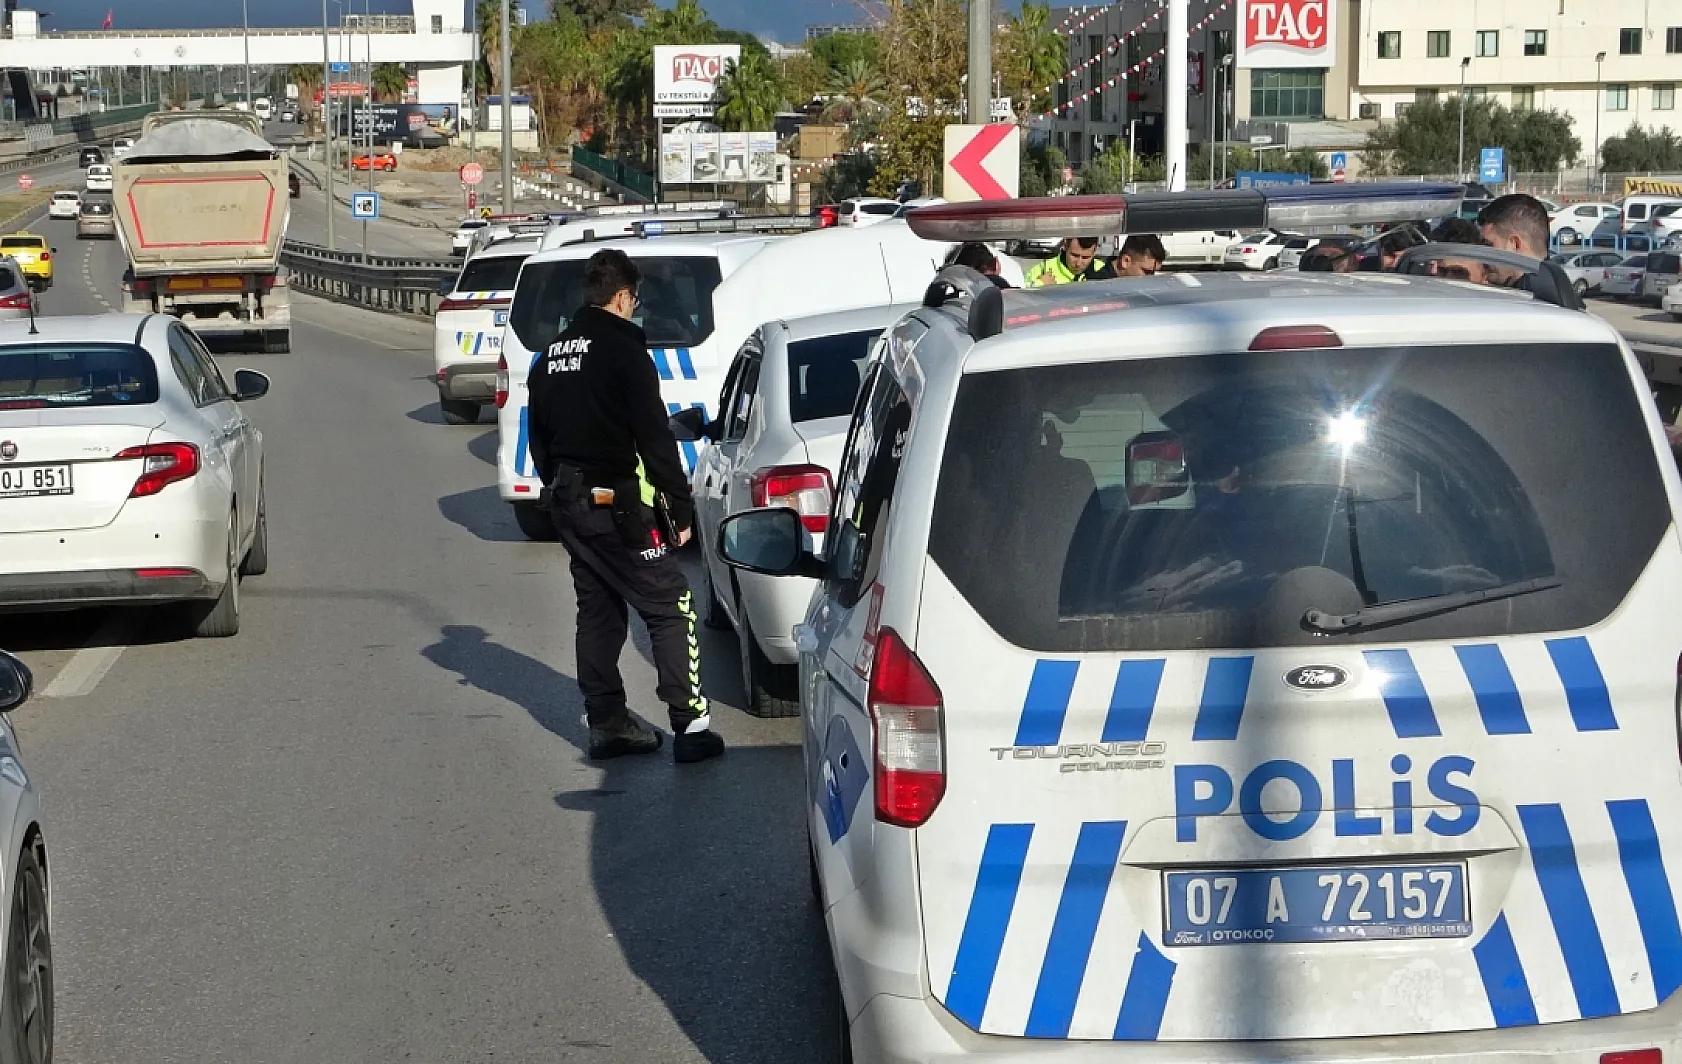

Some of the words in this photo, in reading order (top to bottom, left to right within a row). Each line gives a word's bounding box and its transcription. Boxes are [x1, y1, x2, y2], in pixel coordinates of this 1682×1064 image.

[487, 336, 501, 348] TR
[547, 336, 592, 357] TRAFİK
[33, 467, 65, 488] 851
[640, 543, 667, 560] TRAF
[989, 741, 1166, 760] TOURNEO
[1059, 760, 1165, 772] COURIER
[1185, 877, 1238, 925] 07
[1265, 876, 1289, 924] A
[1317, 871, 1453, 921] 72157
[1174, 931, 1203, 943] Ford
[1212, 928, 1275, 940] OTOKOÇ
